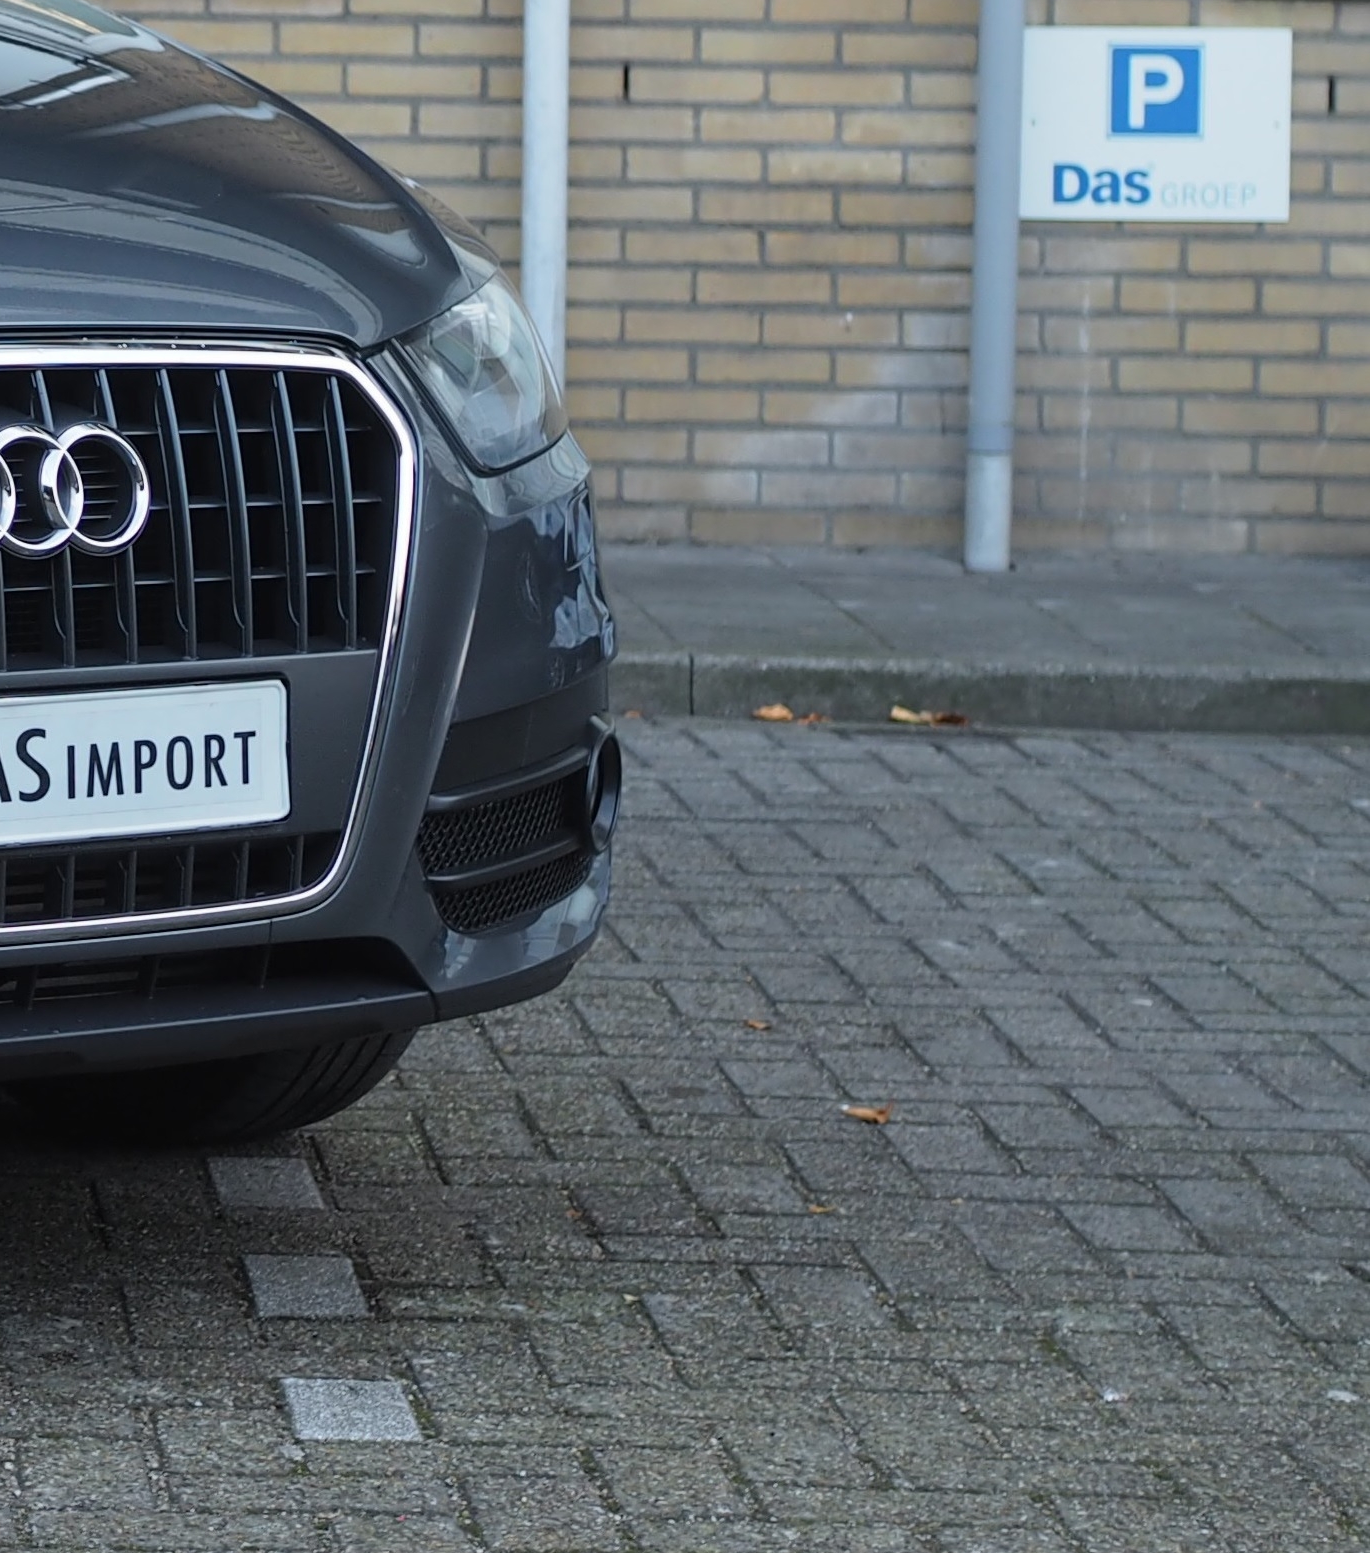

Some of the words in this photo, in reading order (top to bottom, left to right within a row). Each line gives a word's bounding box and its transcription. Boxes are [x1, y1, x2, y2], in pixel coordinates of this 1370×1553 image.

[1128, 53, 1185, 130] P
[1053, 163, 1151, 205] Das
[1162, 183, 1258, 209] GROEP
[67, 730, 257, 800] IMPORT
